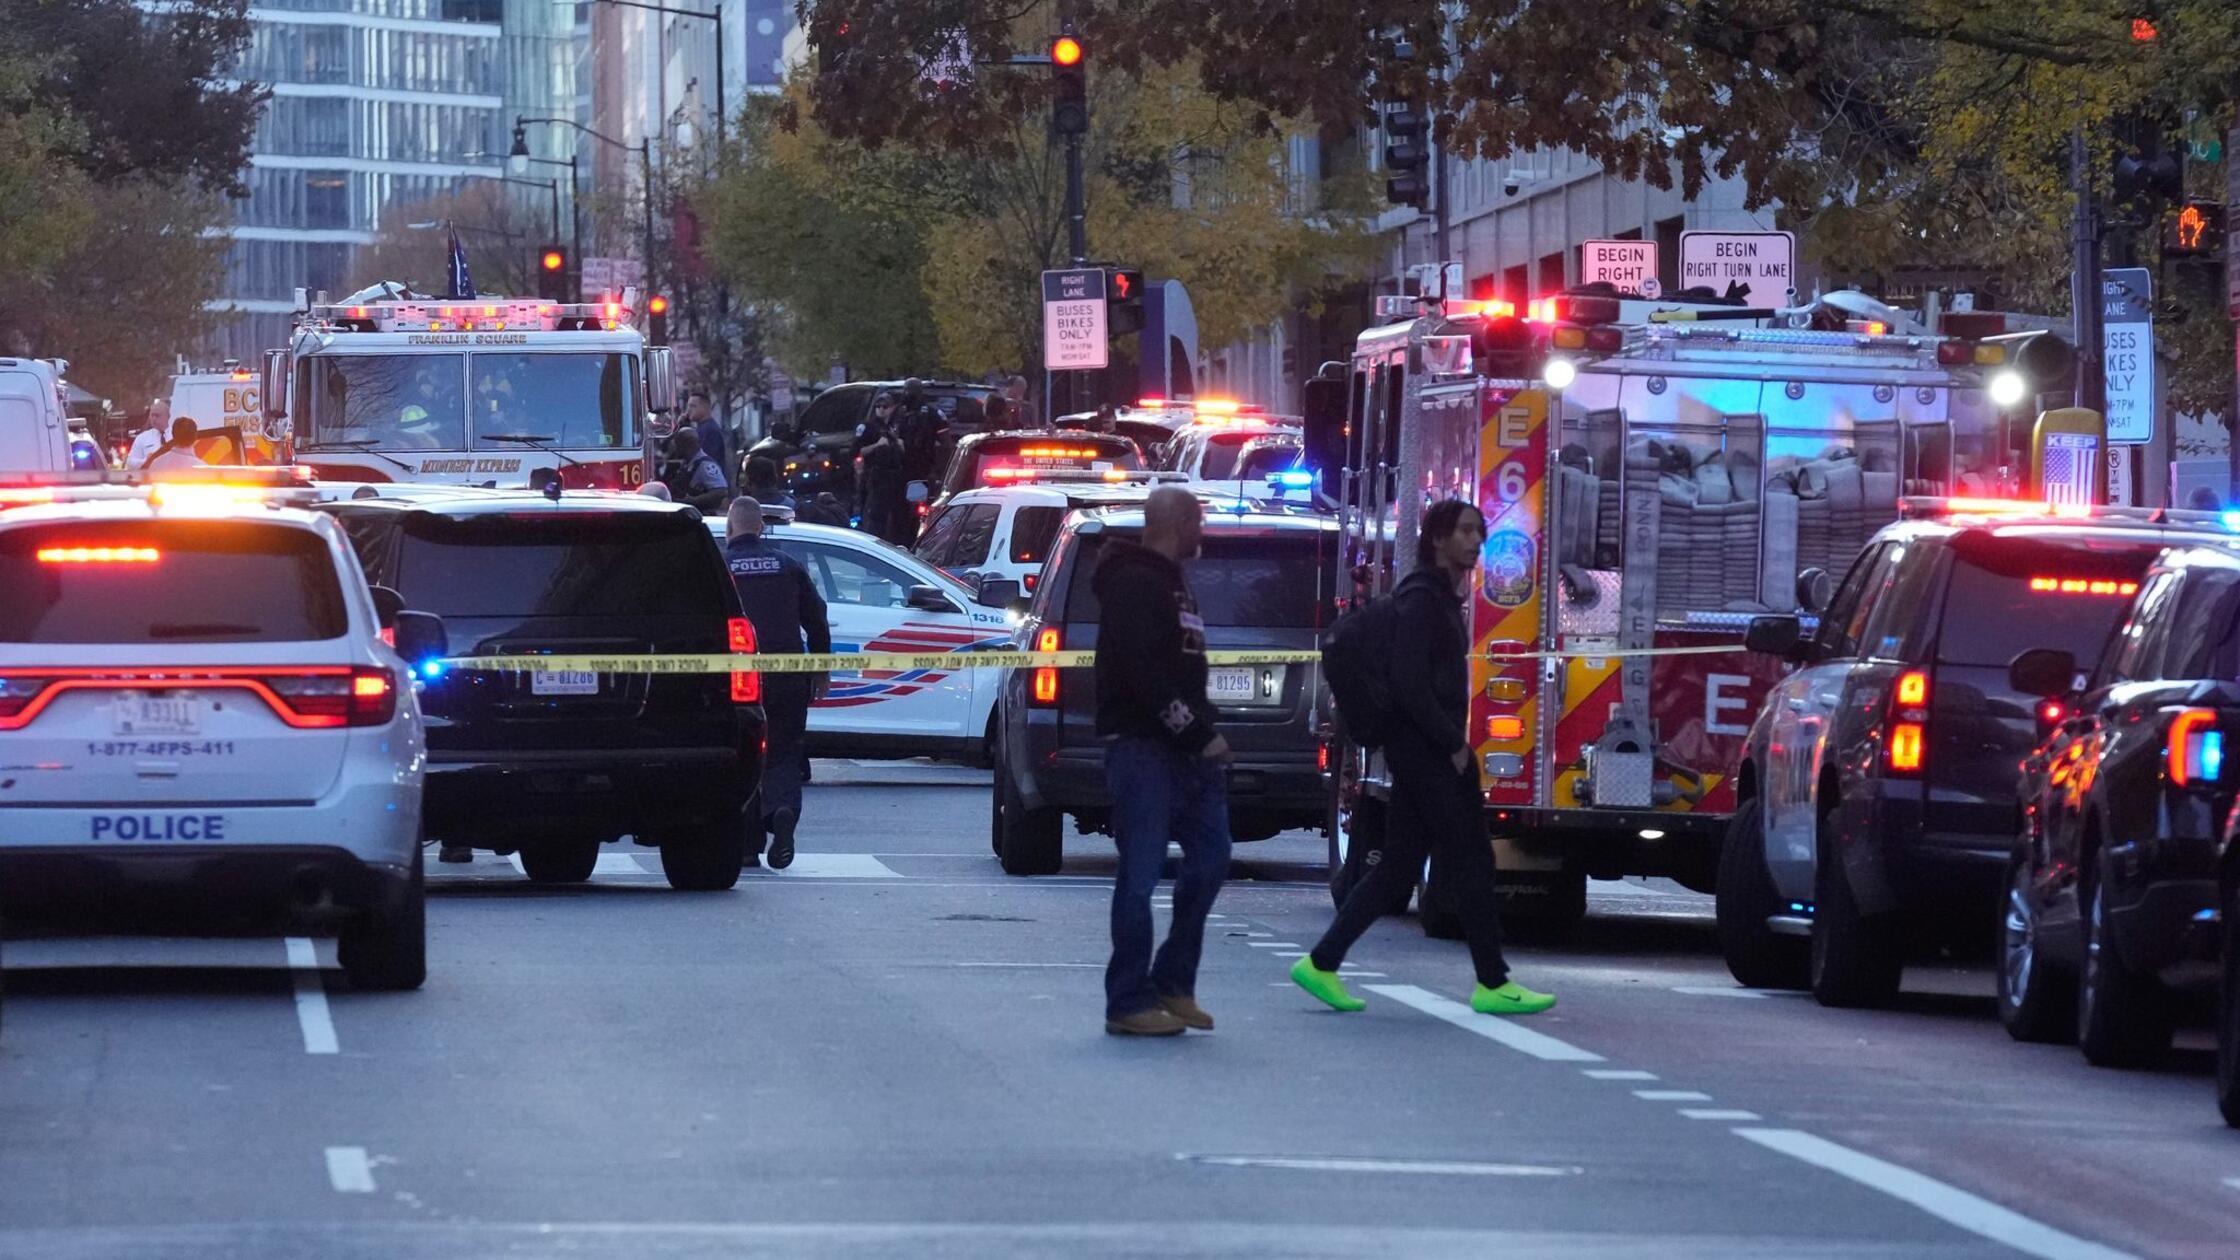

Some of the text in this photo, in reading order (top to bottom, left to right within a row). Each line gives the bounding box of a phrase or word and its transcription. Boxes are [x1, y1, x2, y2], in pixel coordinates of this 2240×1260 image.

[1597, 248, 1645, 262] BEGIN
[1716, 242, 1758, 257] BEGIN
[1598, 266, 1644, 281] RIGHT
[1686, 262, 1788, 278] RIGHT TURN LANE
[1061, 276, 1085, 285] RIGHT
[1063, 288, 1085, 297] LANE
[2103, 281, 2126, 295] IGHT
[1057, 305, 1093, 316] BUSES
[2104, 302, 2126, 316] ANE
[1058, 318, 1094, 328] BIKES
[408, 334, 527, 344] FRANKLIN SQUARE
[1059, 329, 1092, 340] ONLY
[2108, 354, 2137, 371] KES
[2106, 375, 2135, 391] NLY
[1499, 407, 1529, 447] E
[2047, 435, 2097, 450] KEEP
[420, 459, 521, 473] MIDNIGHT EXPRESS
[619, 464, 641, 485] 16
[1499, 461, 1526, 500] 6
[730, 560, 780, 572] POLICE
[678, 658, 708, 669] POLICE
[818, 658, 837, 669] LINE
[840, 658, 871, 669] POLICE
[980, 656, 998, 667] LINE
[1002, 655, 1033, 667] POLICE
[1216, 675, 1250, 691] 81295
[88, 741, 234, 756] 1-877-4FPS-411
[91, 815, 224, 840] POLICE
